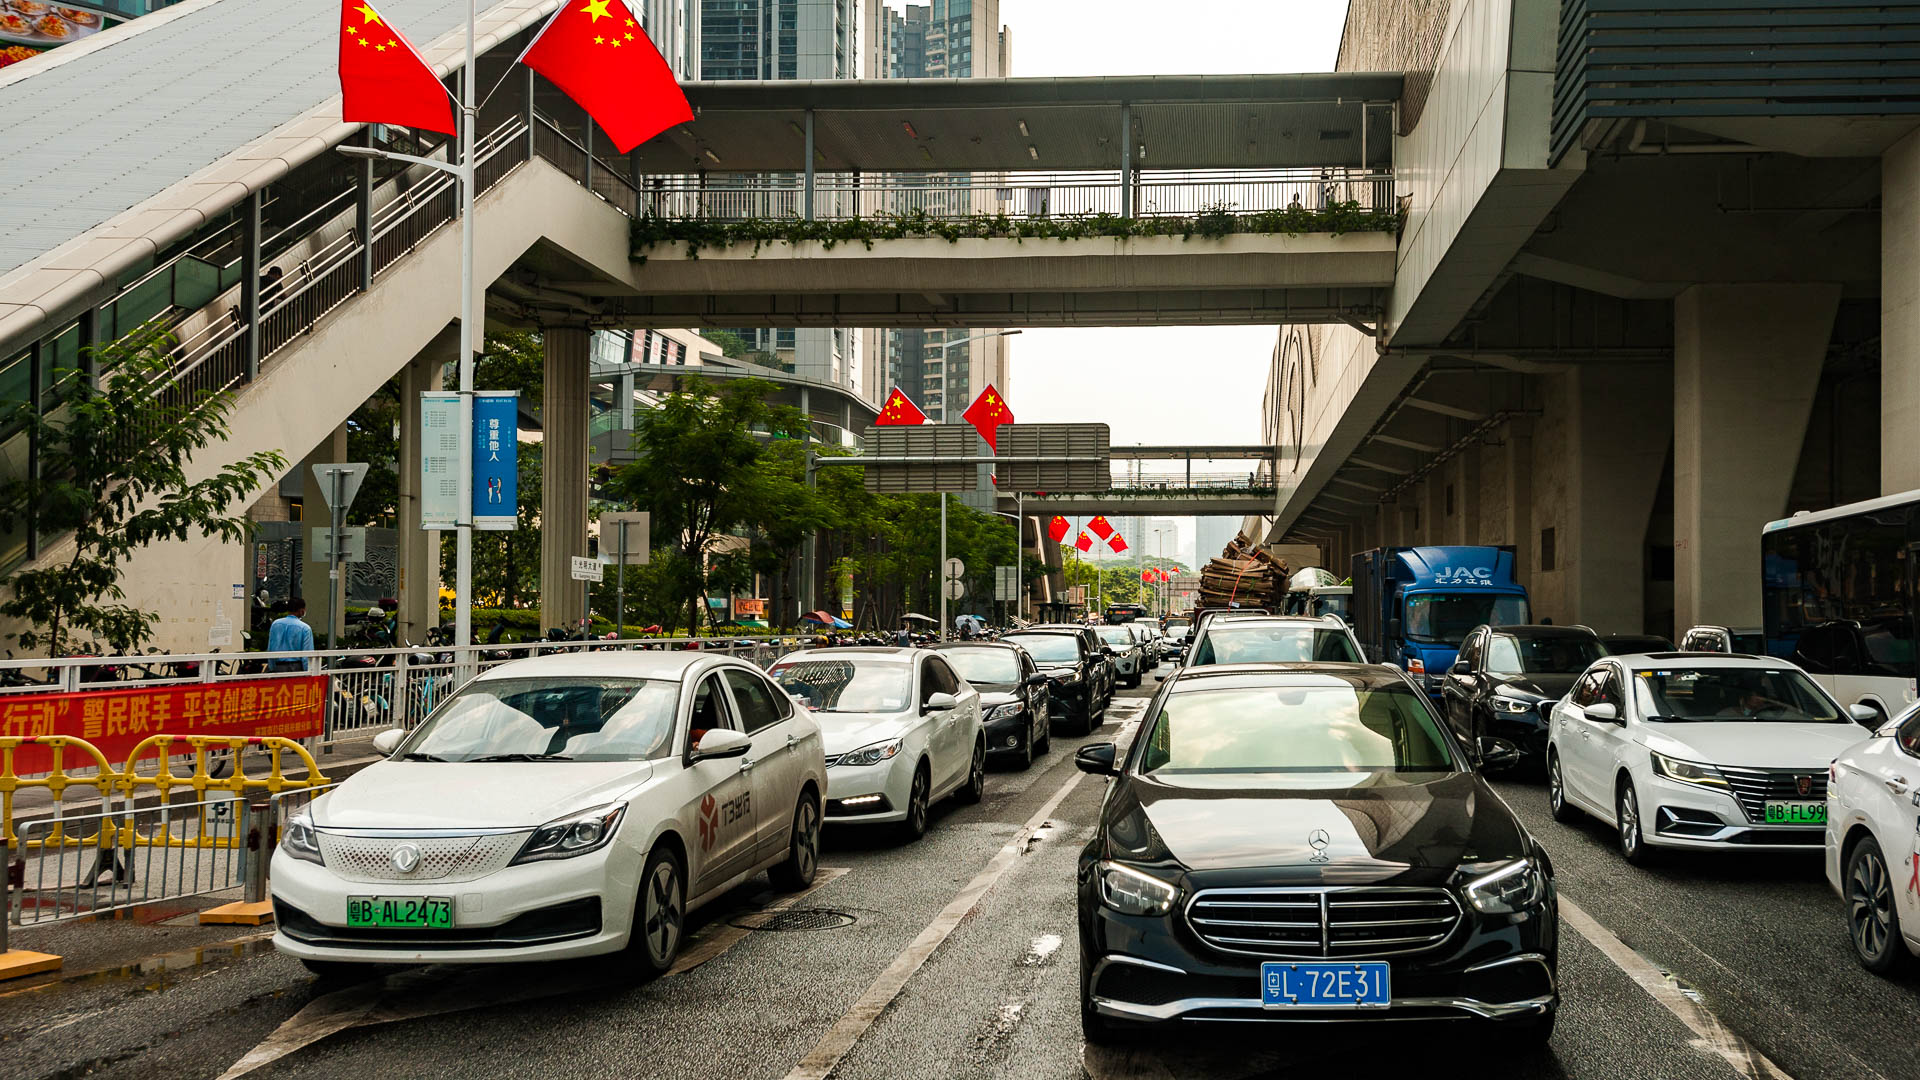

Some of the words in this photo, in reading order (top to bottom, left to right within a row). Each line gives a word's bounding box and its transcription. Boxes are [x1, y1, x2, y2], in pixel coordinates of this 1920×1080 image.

[489, 418, 500, 462] 尊重他人
[1435, 566, 1492, 578] JAC
[82, 693, 172, 739] 警民联手
[182, 681, 322, 729] 平安创建万众同心
